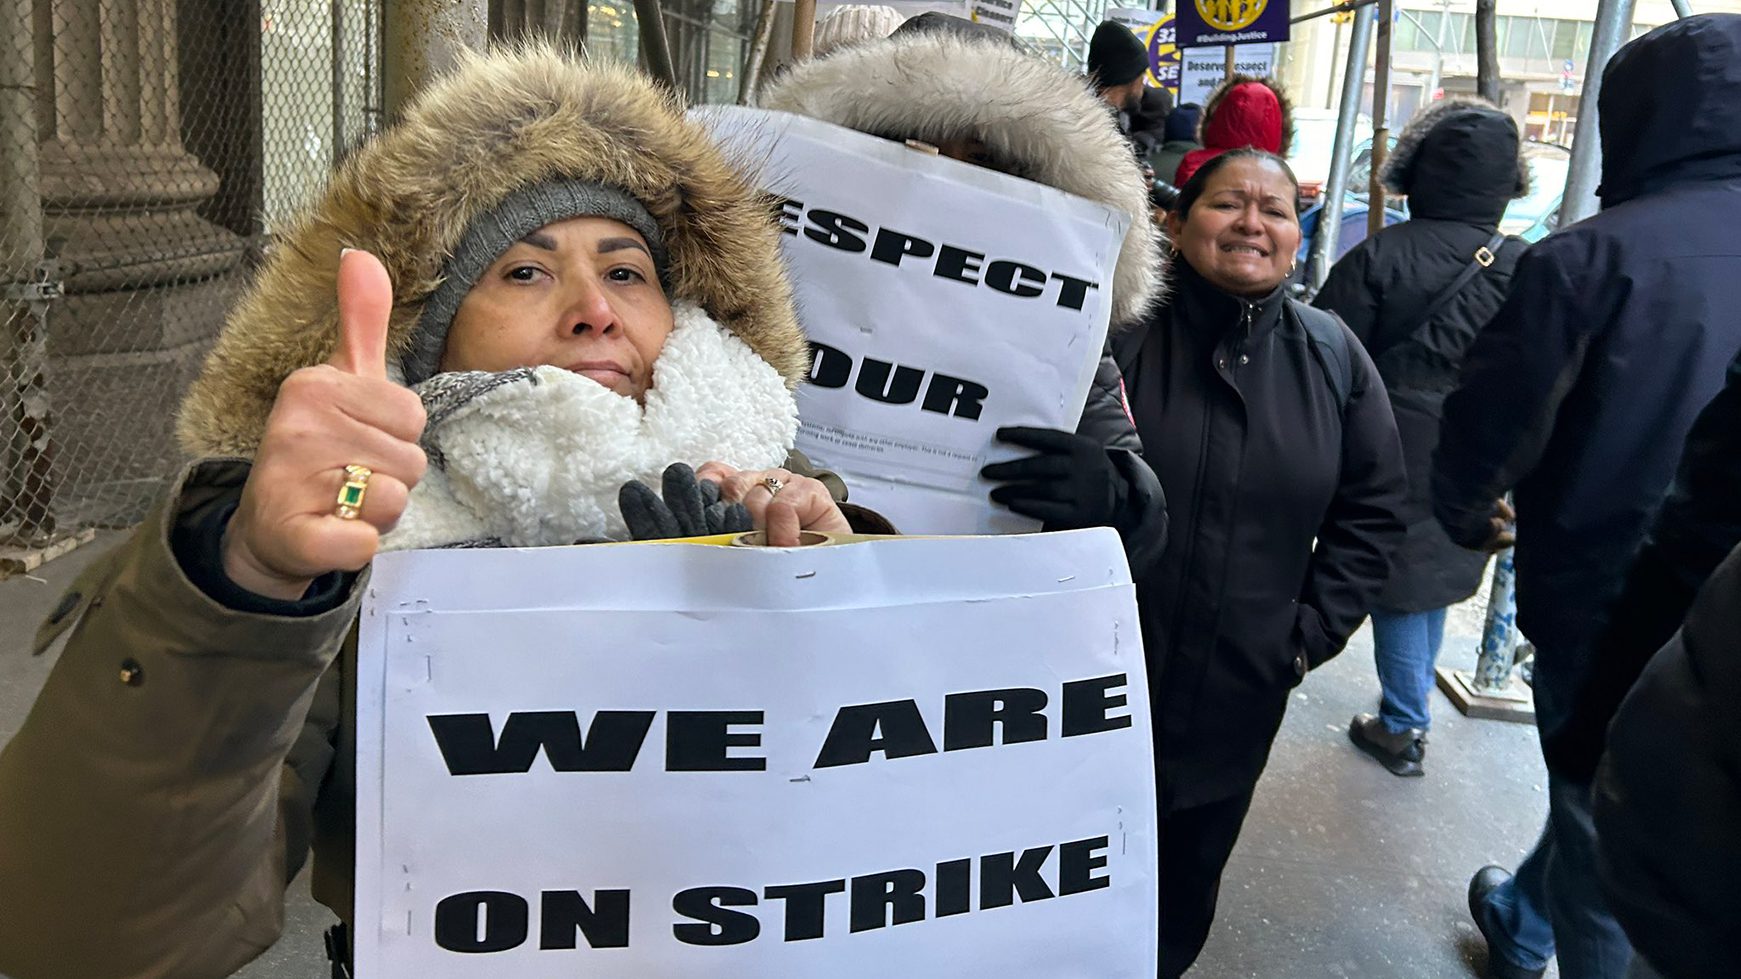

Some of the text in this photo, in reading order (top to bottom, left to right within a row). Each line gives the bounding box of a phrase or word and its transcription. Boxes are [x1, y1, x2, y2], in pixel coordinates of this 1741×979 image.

[1234, 61, 1268, 75] espect
[776, 199, 1099, 312] ESPECT
[426, 673, 1132, 777] WE ARE
[434, 835, 1110, 954] ON STRIKE
